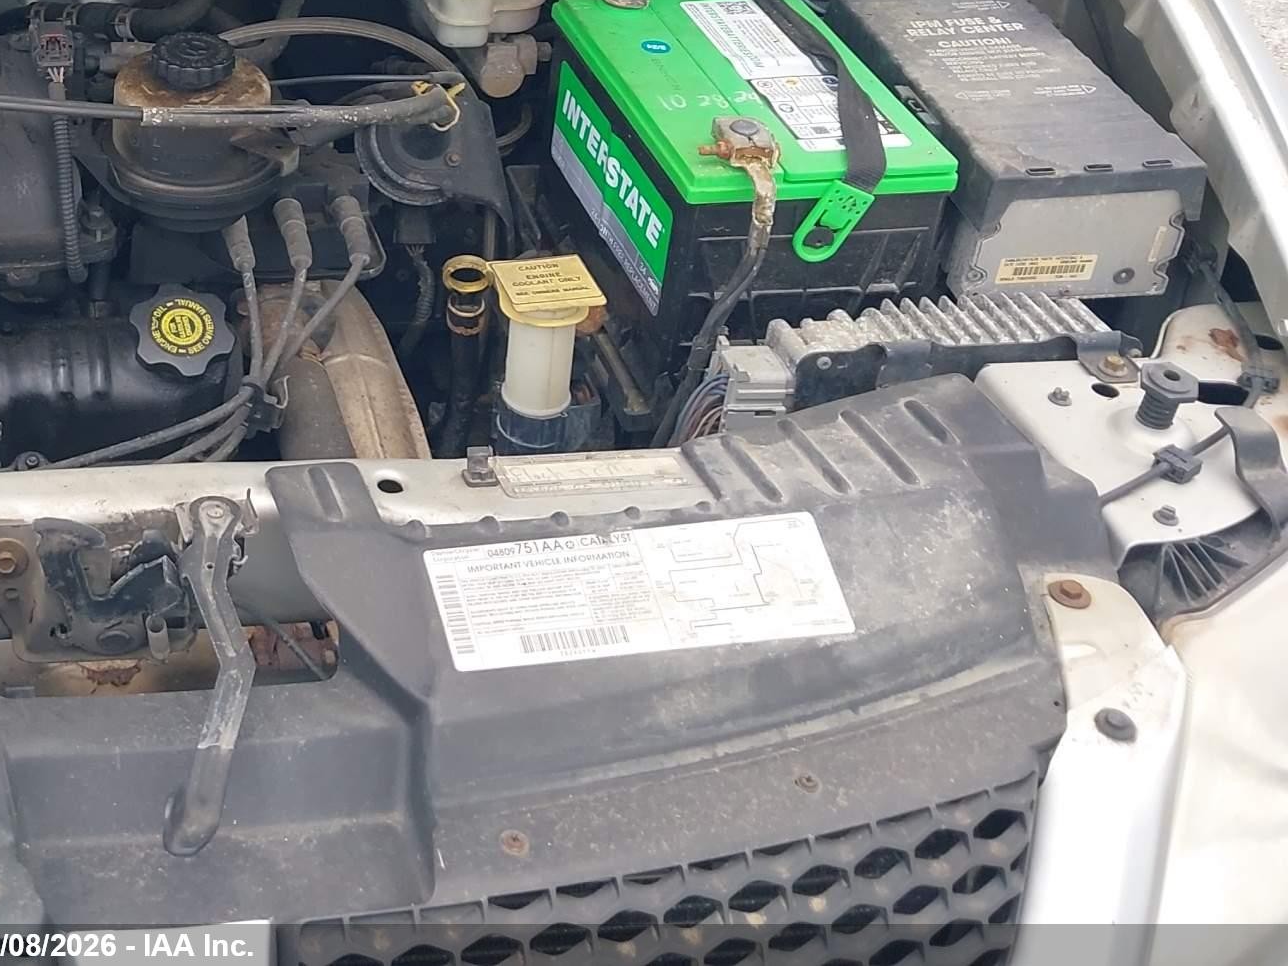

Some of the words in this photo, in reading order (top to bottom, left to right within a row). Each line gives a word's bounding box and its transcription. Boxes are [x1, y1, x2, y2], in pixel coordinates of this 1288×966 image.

[905, 25, 960, 37] RELAY
[961, 22, 1026, 34] CENTER
[911, 19, 943, 30] IPM
[945, 17, 985, 27] FUSE
[988, 15, 1003, 25] &
[938, 36, 1012, 48] CAUTION!
[562, 90, 663, 249] INTERSTATE
[518, 263, 560, 272] CAUTION
[512, 279, 554, 287] COOLANT
[525, 272, 563, 280] ENGINE
[152, 305, 168, 319] OIL
[467, 561, 521, 574] IMPORTANT
[525, 557, 561, 569] VEHICLE
[563, 551, 630, 566] INFORMATION
